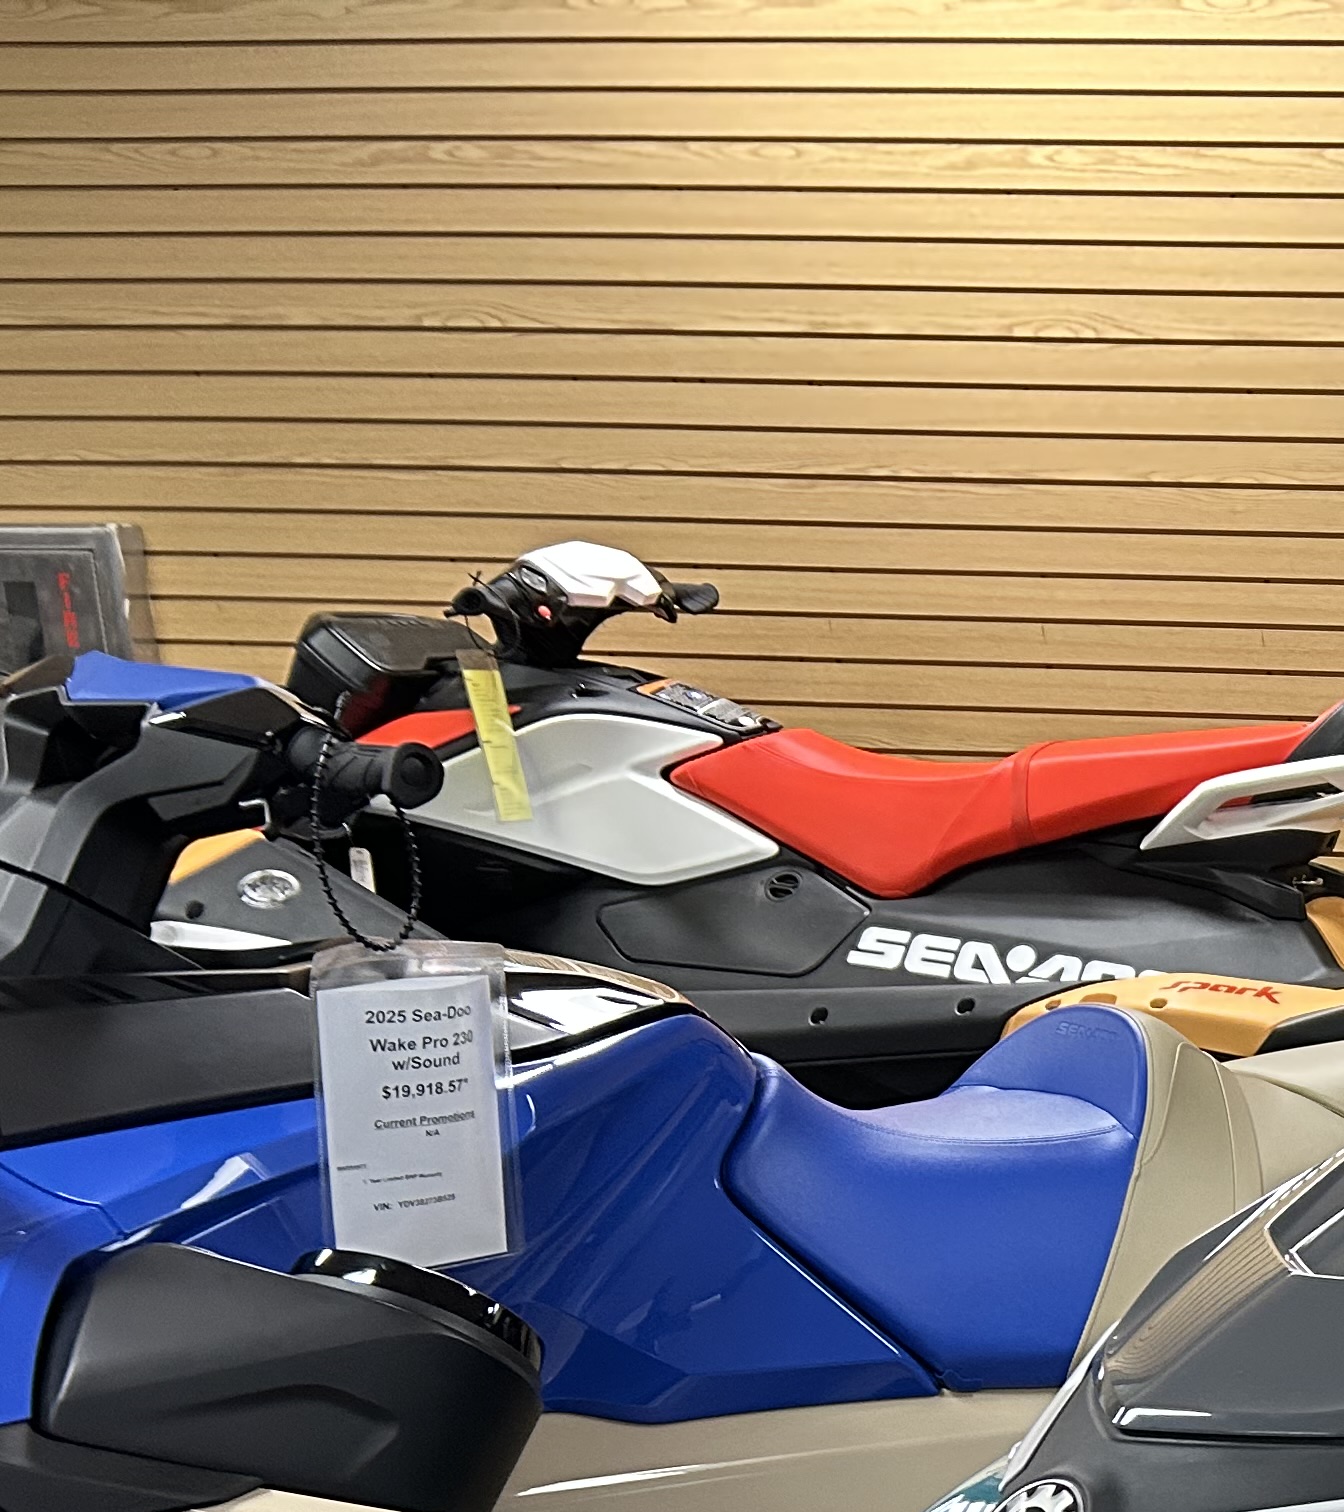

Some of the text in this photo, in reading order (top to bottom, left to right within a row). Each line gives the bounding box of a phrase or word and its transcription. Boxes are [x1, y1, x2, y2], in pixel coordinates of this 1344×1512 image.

[1159, 981, 1282, 1005] spark
[365, 1005, 472, 1024] 2025 Sea-Doo
[369, 1029, 474, 1052] Wake Pro 230
[392, 1052, 461, 1071] w/Sound
[374, 1110, 475, 1130] Current Promotions
